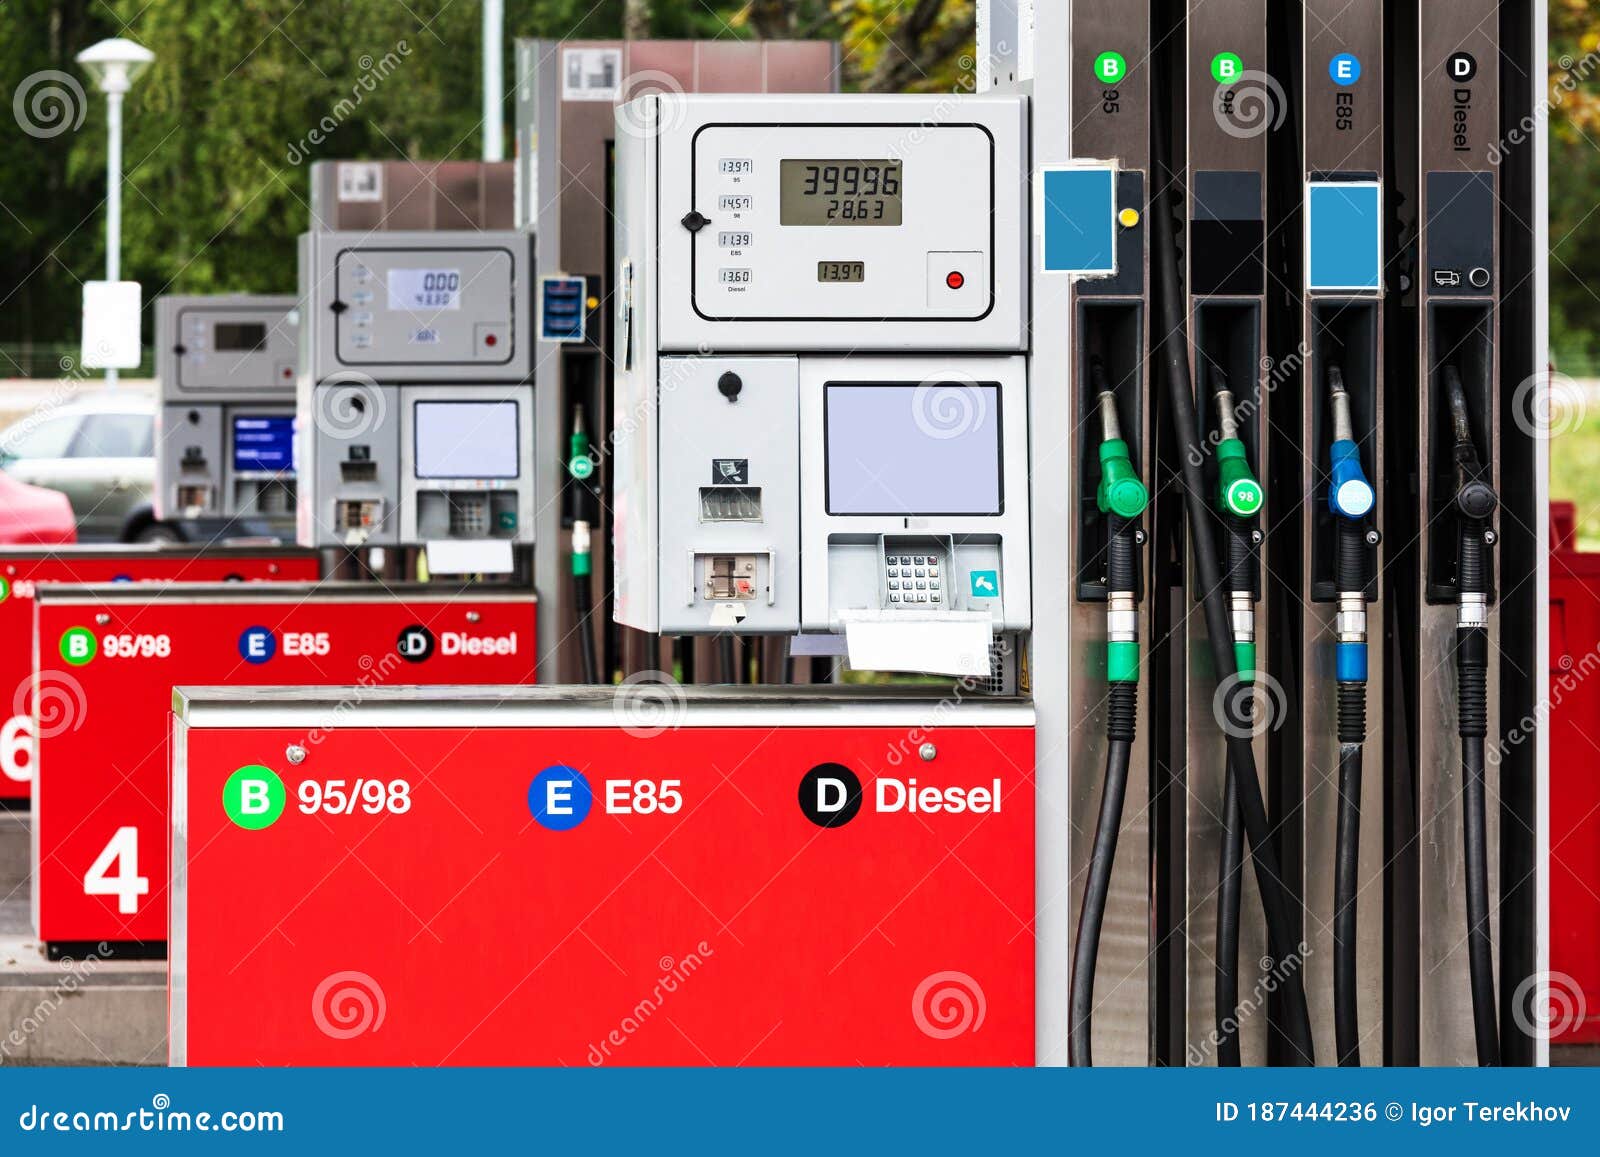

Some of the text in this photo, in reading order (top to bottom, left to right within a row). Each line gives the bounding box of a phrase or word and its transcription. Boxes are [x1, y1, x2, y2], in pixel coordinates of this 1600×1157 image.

[1103, 58, 1119, 77] B
[1219, 59, 1236, 77] B
[1337, 60, 1352, 78] E
[1454, 58, 1471, 76] D
[1102, 89, 1120, 114] 95
[1218, 90, 1236, 115] 98
[1336, 92, 1353, 131] E85
[1453, 88, 1471, 152] Diesel
[803, 166, 899, 197] 399,96
[827, 200, 884, 220] 28,63
[823, 264, 863, 281] 13,97
[1238, 491, 1254, 502] 98
[69, 633, 172, 658] B 95/98
[248, 632, 331, 656] E E85
[407, 631, 518, 656] D Diesel
[0, 714, 34, 783] 6
[240, 778, 412, 815] B 95/98
[545, 779, 683, 815] E E85
[816, 777, 1002, 814] D Diesel
[83, 825, 149, 914] 4
